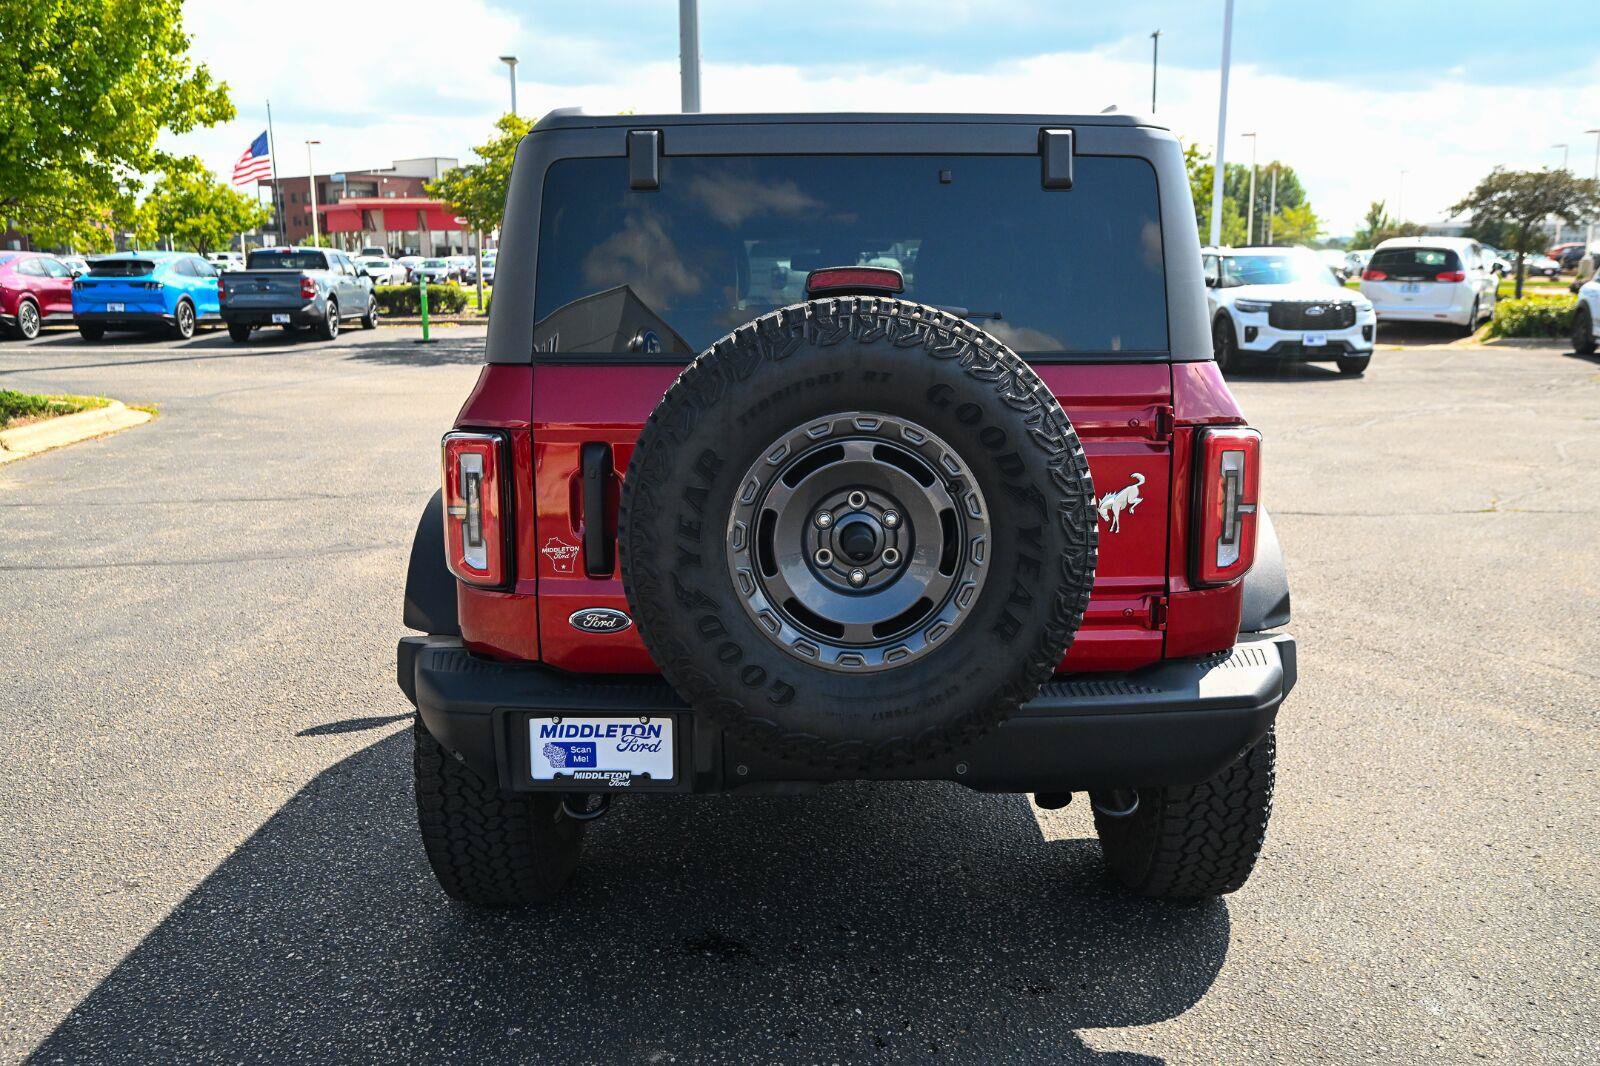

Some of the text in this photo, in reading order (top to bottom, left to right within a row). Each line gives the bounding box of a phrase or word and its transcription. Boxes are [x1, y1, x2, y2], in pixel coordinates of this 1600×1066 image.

[541, 546, 580, 554] MIDDLETON
[583, 613, 617, 628] Ford
[539, 724, 662, 738] MIDDLETON
[616, 734, 662, 753] Ford
[570, 746, 592, 754] Scan
[573, 772, 630, 780] MIDDLETON
[608, 778, 631, 787] Ford
